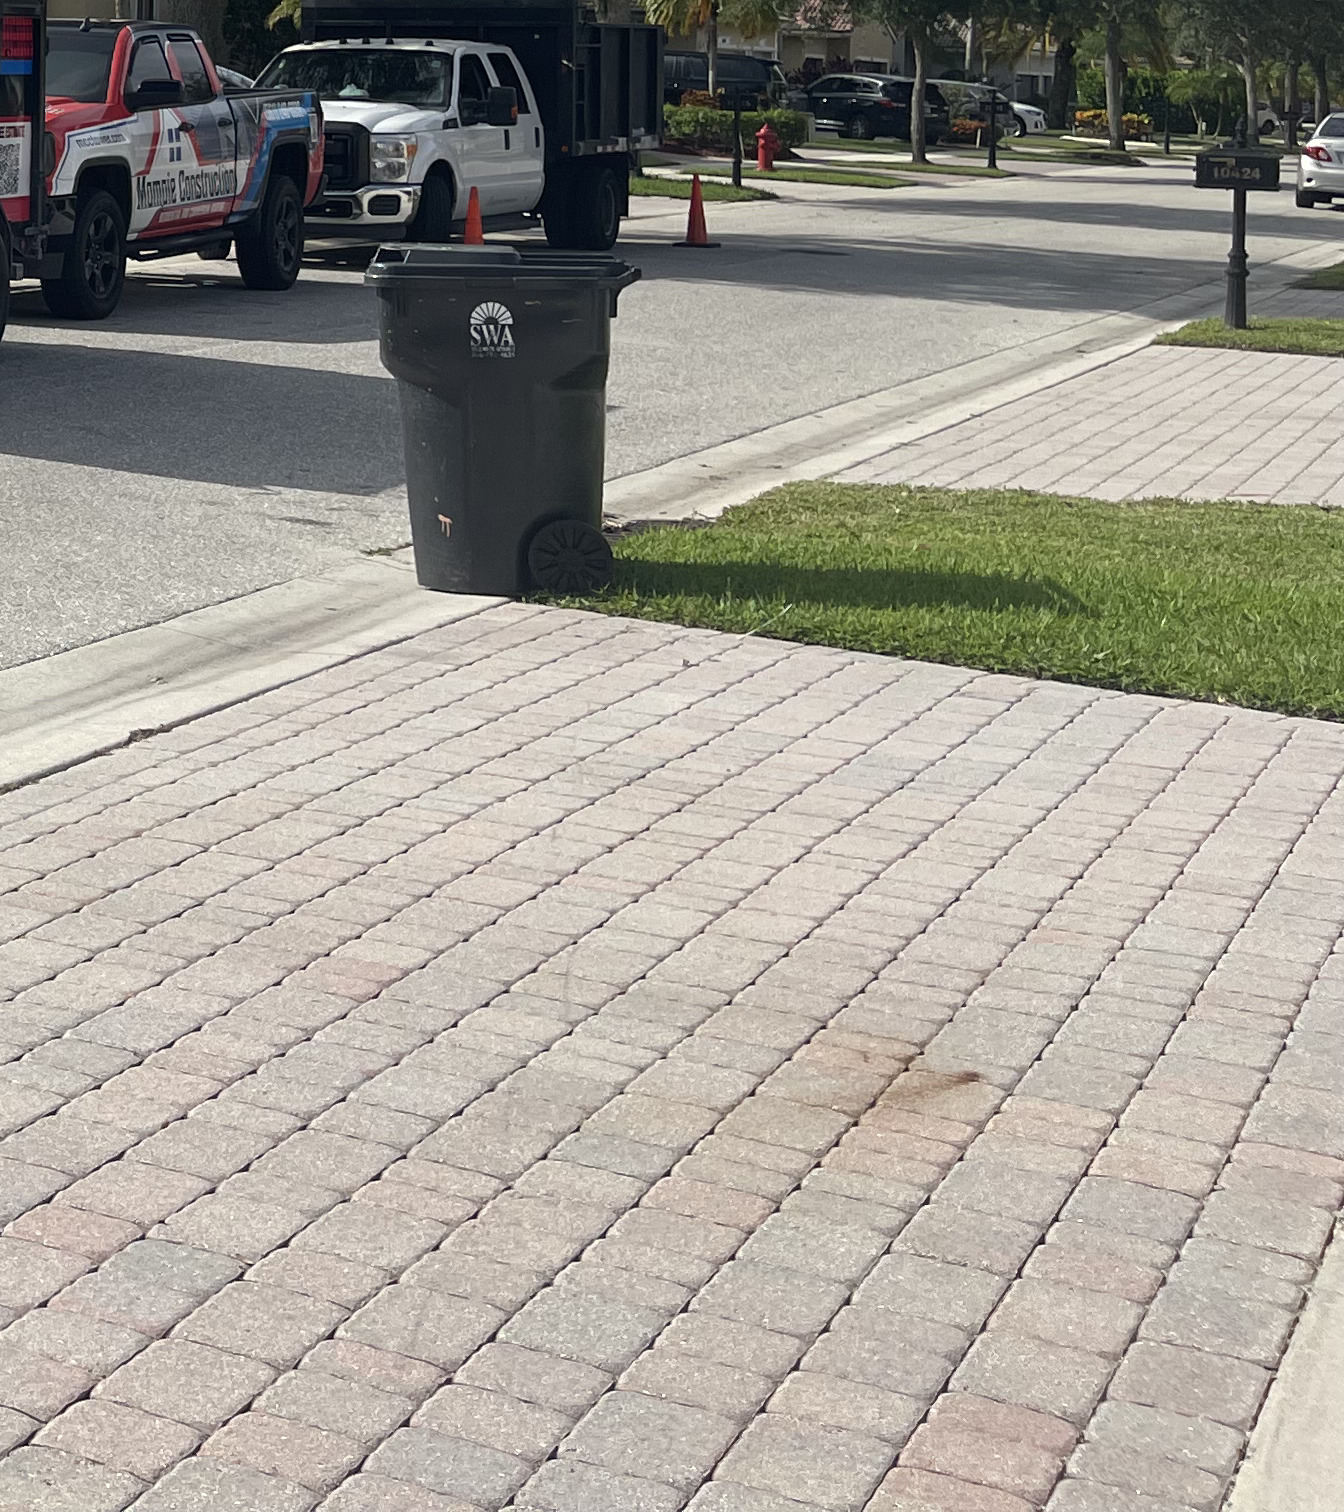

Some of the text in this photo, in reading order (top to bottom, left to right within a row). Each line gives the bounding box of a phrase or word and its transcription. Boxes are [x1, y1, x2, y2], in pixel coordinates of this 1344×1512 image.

[136, 164, 236, 210] Mompie Construction
[469, 324, 516, 347] SWA
